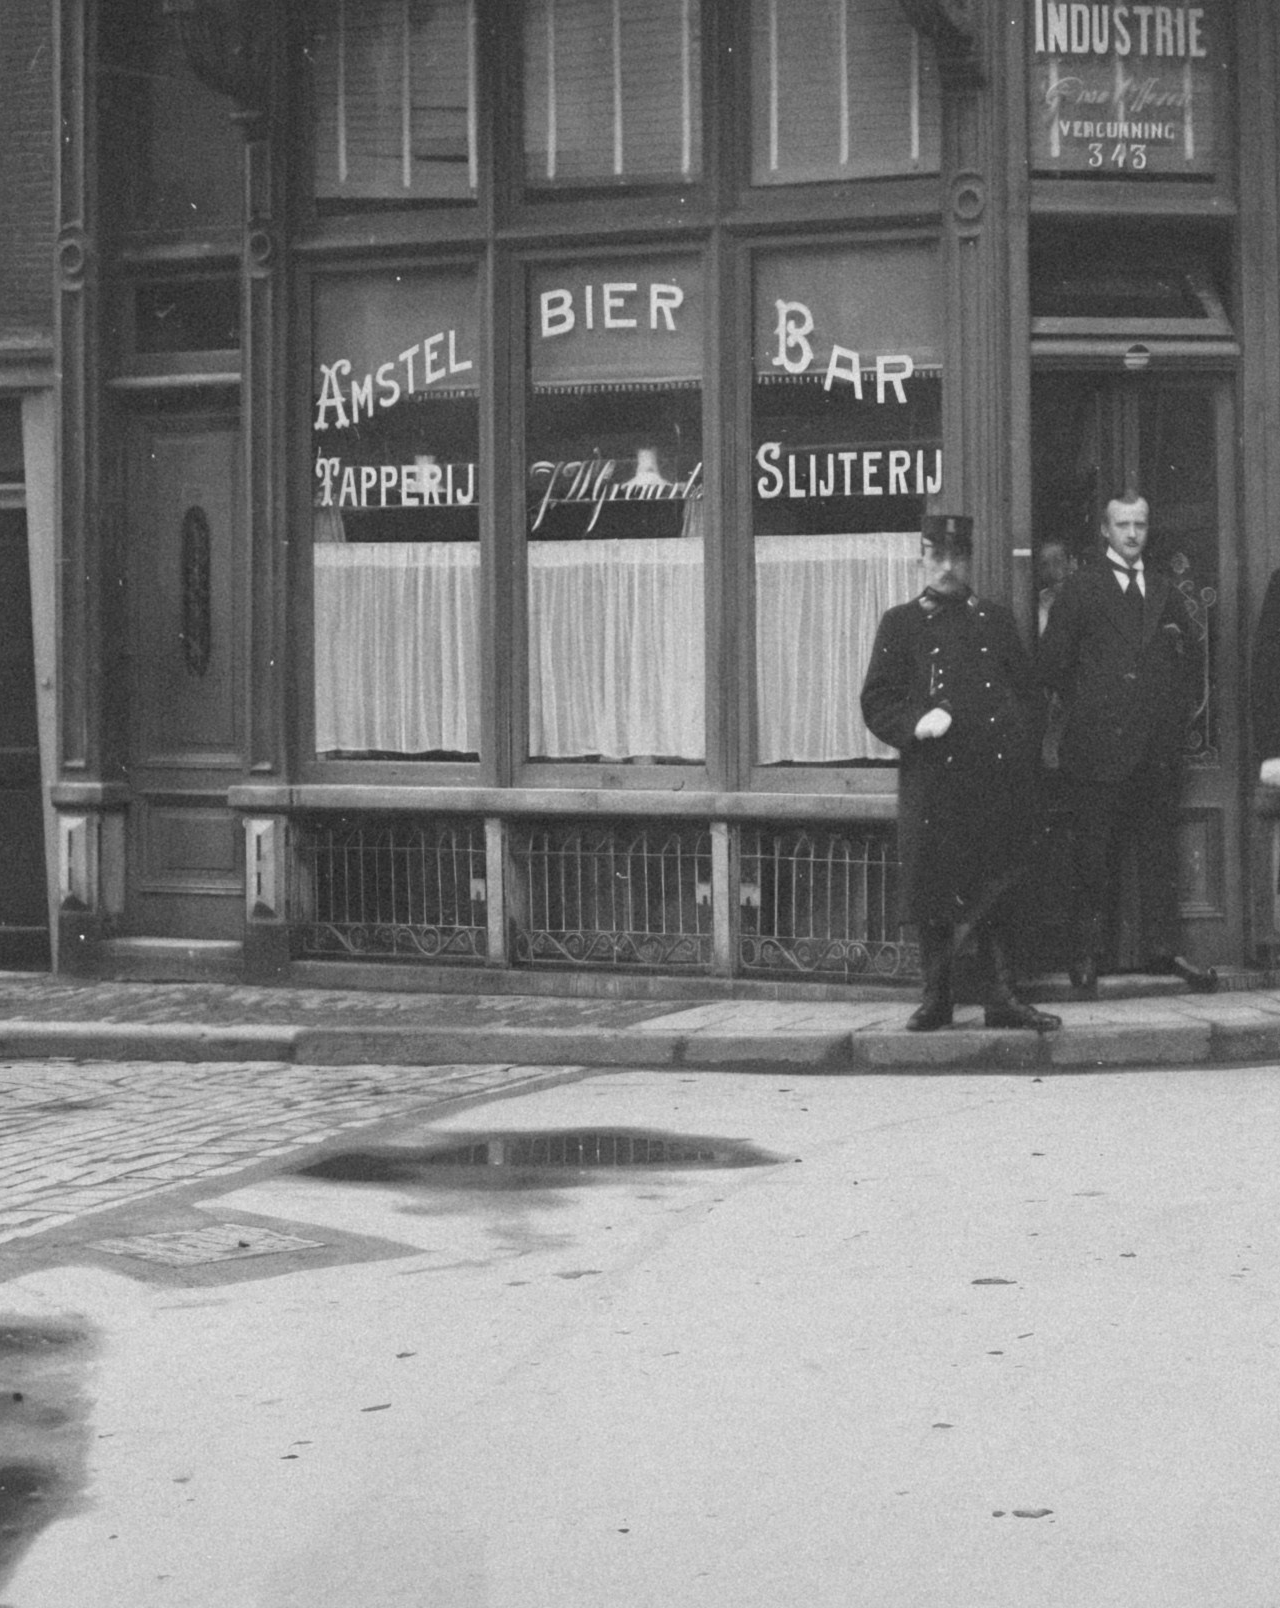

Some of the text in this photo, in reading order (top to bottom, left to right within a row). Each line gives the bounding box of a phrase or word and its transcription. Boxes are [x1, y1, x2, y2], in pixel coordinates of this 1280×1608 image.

[1059, 120, 1175, 139] VERGUNNING
[1088, 143, 1147, 169] 343
[313, 282, 914, 431] AMSTEL BIER BAR
[315, 456, 475, 507] TAPPERIJ
[755, 442, 942, 498] SLIJTERIJ
